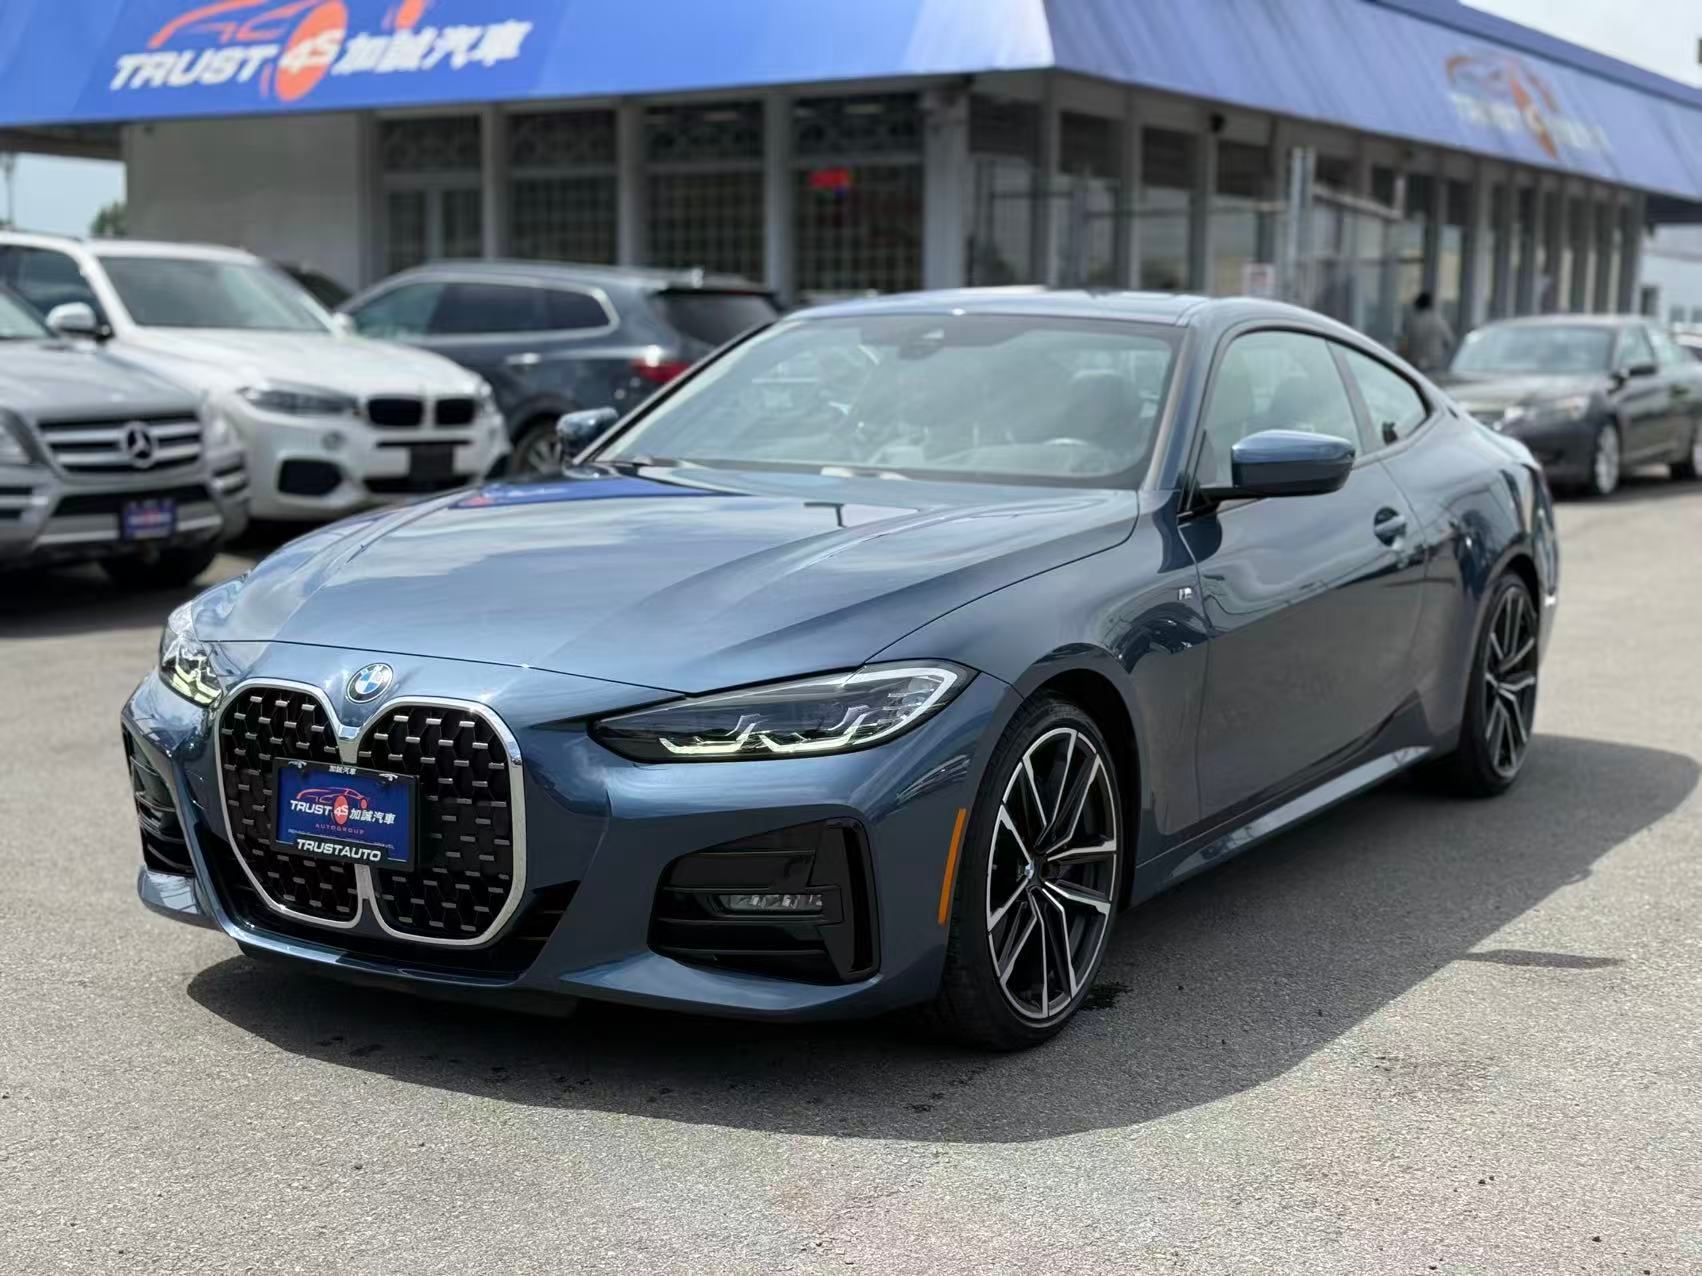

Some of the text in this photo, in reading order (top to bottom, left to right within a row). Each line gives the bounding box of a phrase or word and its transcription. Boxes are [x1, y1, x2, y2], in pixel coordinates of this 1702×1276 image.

[110, 45, 280, 90] TRUST
[290, 800, 397, 825] TRUST 4S 加誠汽車
[315, 823, 365, 835] AUTOGROUP
[296, 838, 382, 862] TRUSTAUTO
